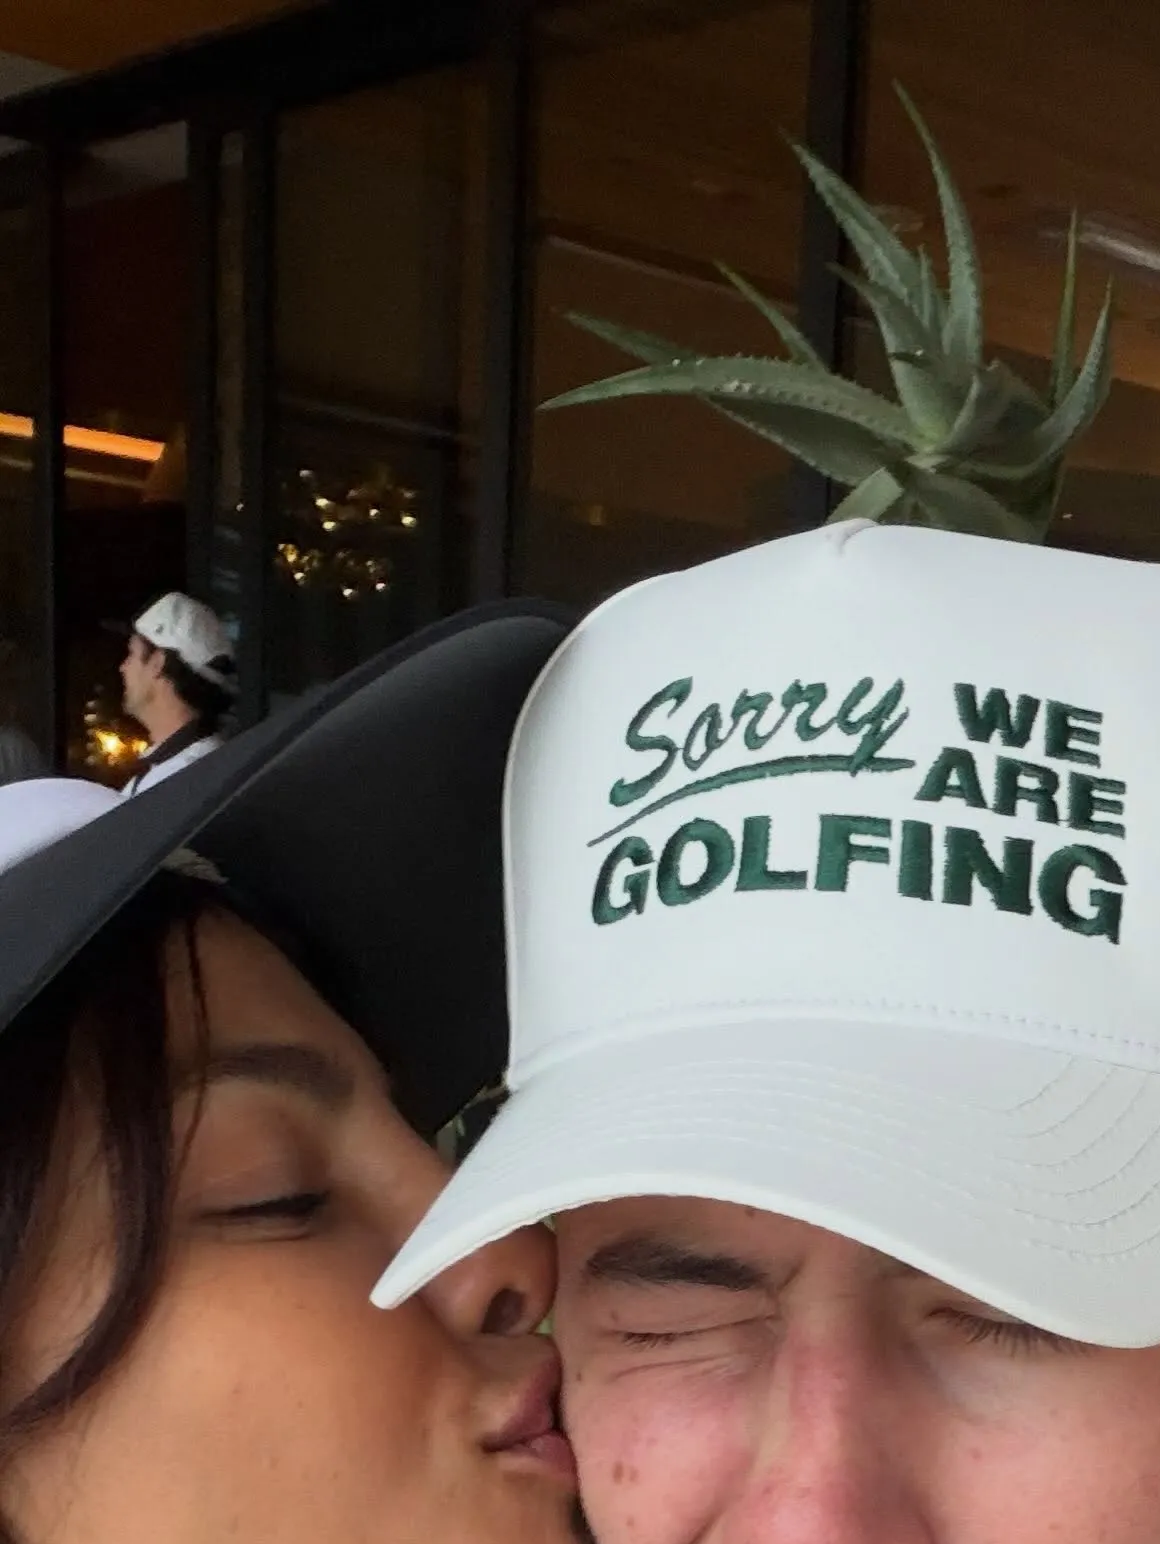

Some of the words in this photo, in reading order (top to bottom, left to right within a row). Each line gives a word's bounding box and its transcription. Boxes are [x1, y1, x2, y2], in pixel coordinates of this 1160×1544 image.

[608, 675, 910, 807] Sorry
[952, 681, 1104, 769] WE
[913, 745, 1127, 840] ARE
[591, 813, 1128, 946] GOLFING
